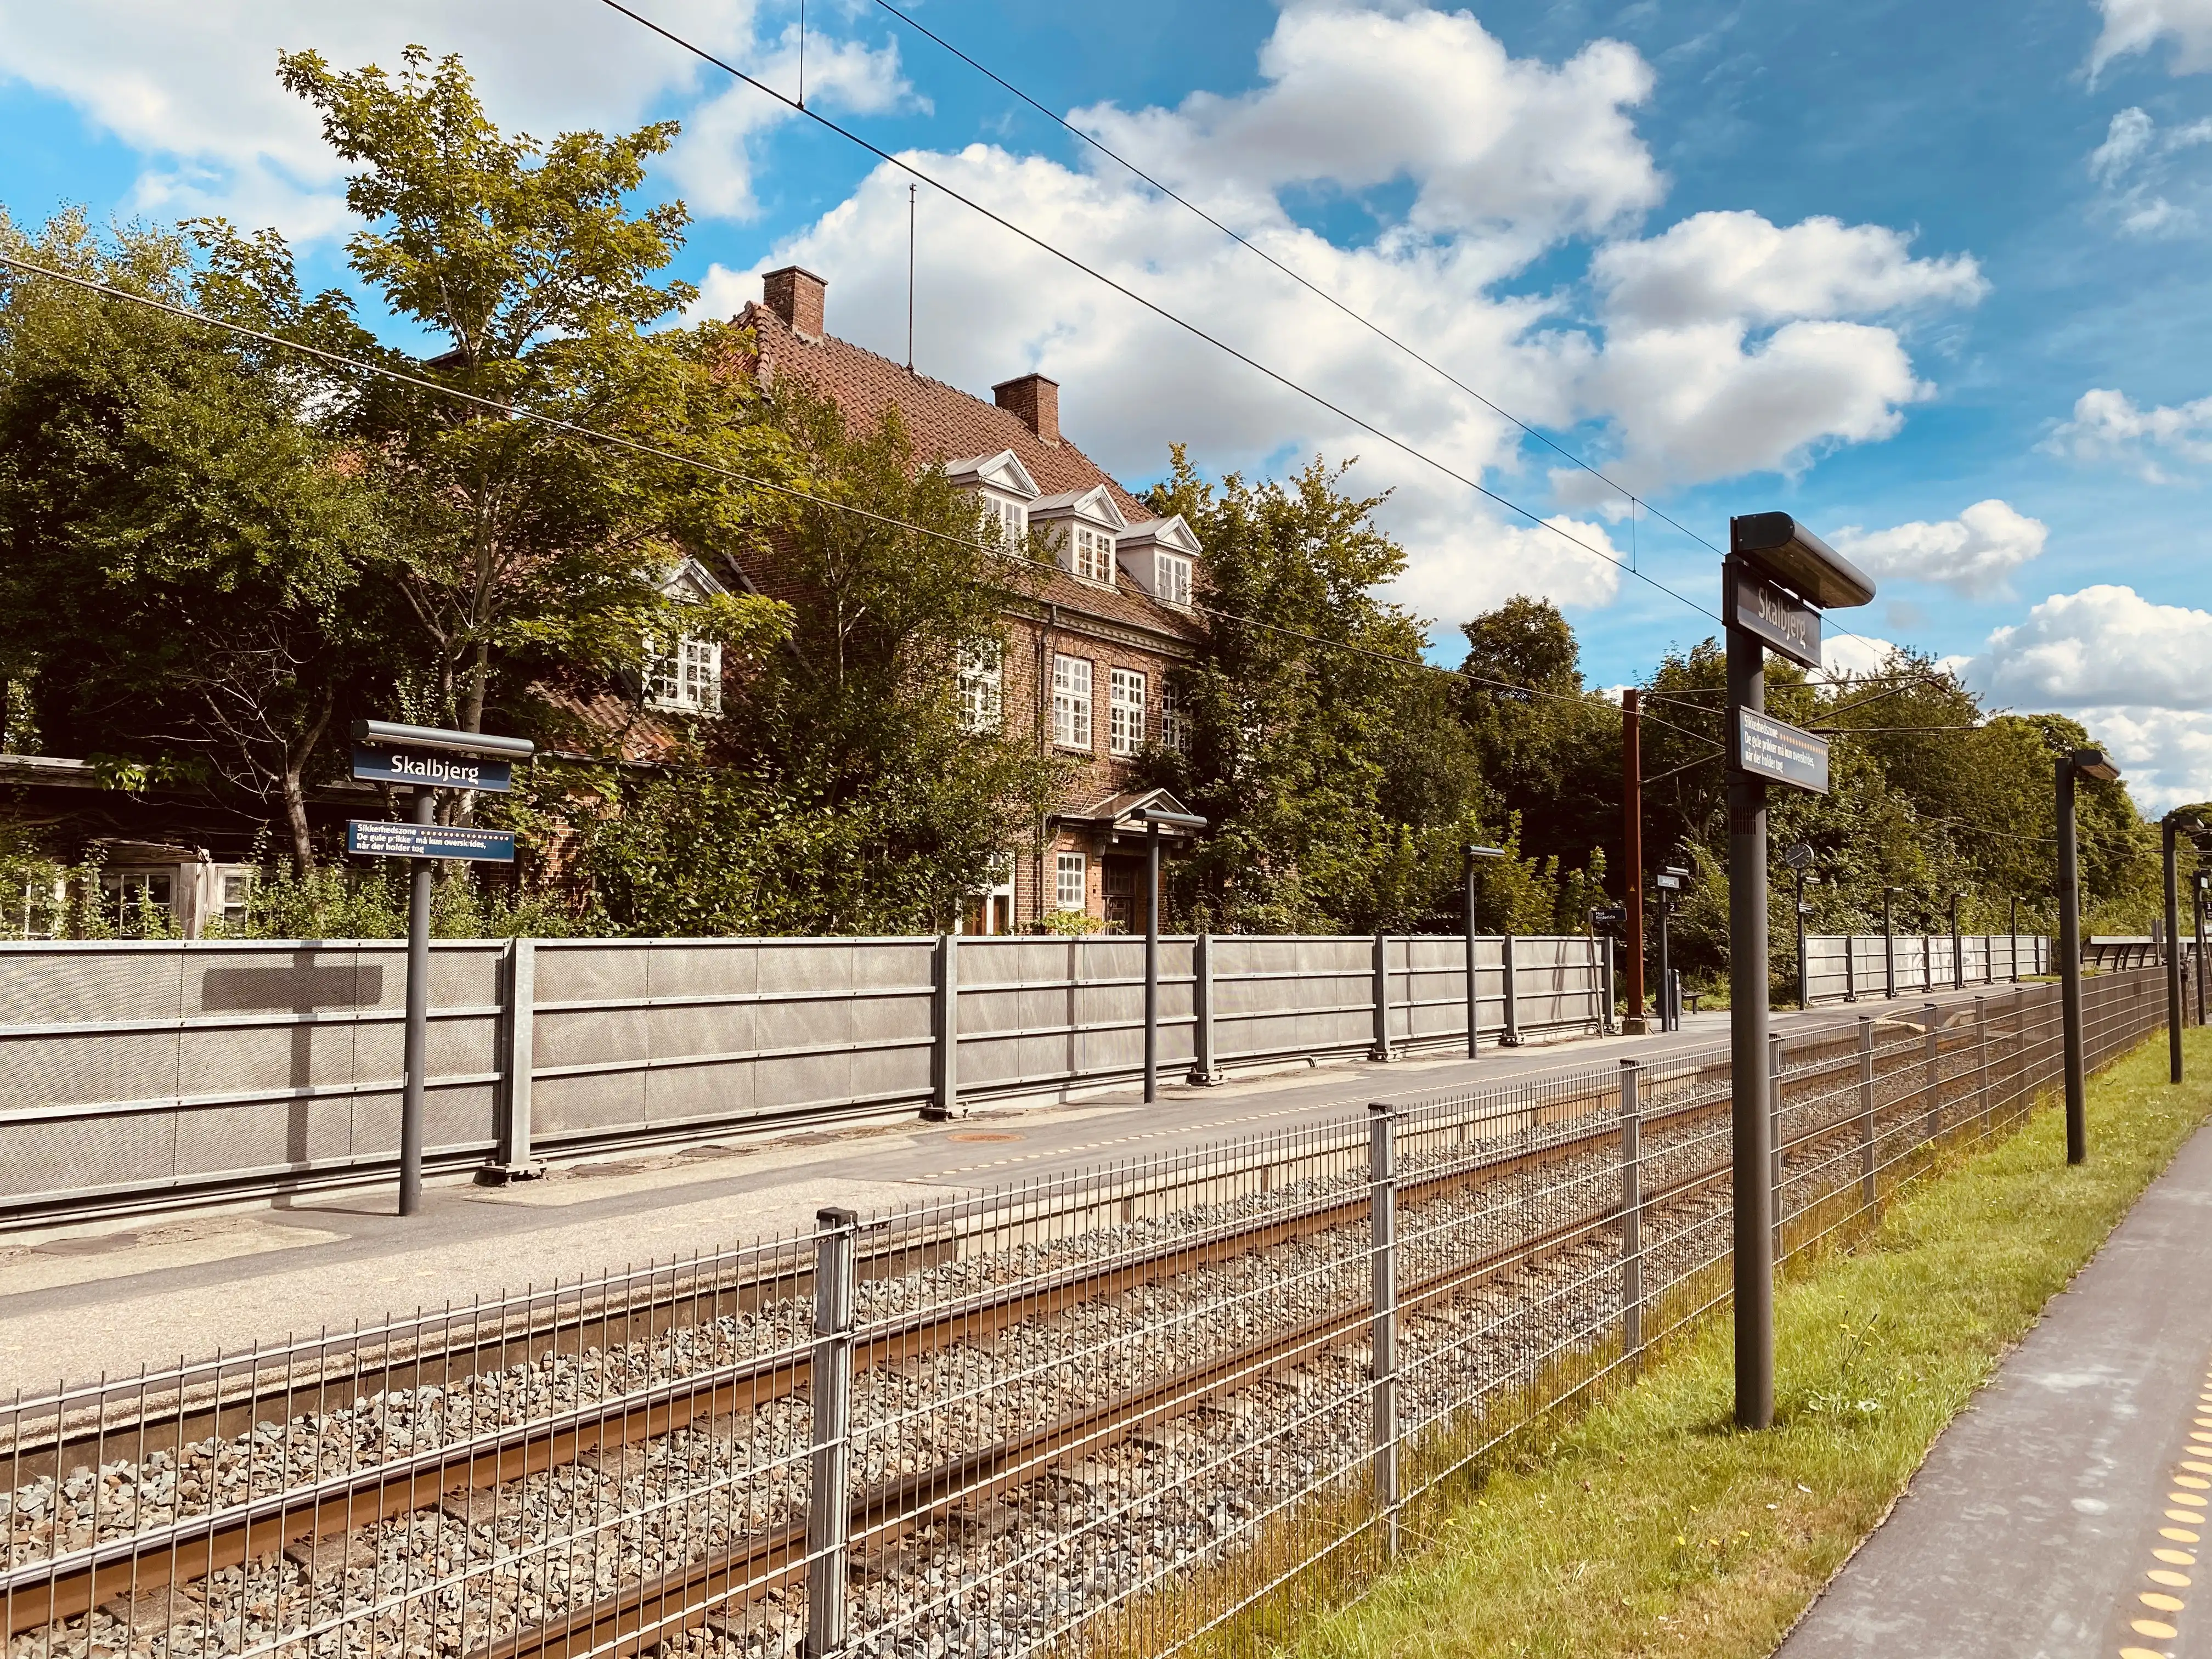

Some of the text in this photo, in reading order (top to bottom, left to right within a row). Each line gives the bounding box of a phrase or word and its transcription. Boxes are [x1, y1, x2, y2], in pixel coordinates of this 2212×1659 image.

[1758, 586, 1807, 650] Skalbjerg
[1744, 714, 1779, 739] Sikkerhedszone
[1744, 731, 1815, 769] De gule prikker må kun overskrides,
[1745, 748, 1784, 774] når der holder tog
[391, 755, 479, 785] Skalbjerg
[357, 824, 417, 836] Sikkerhedszone
[369, 833, 386, 843] gule
[387, 834, 413, 844] pikke
[415, 836, 427, 844] må
[428, 836, 443, 845] kun
[356, 840, 425, 854] når der holder tog
